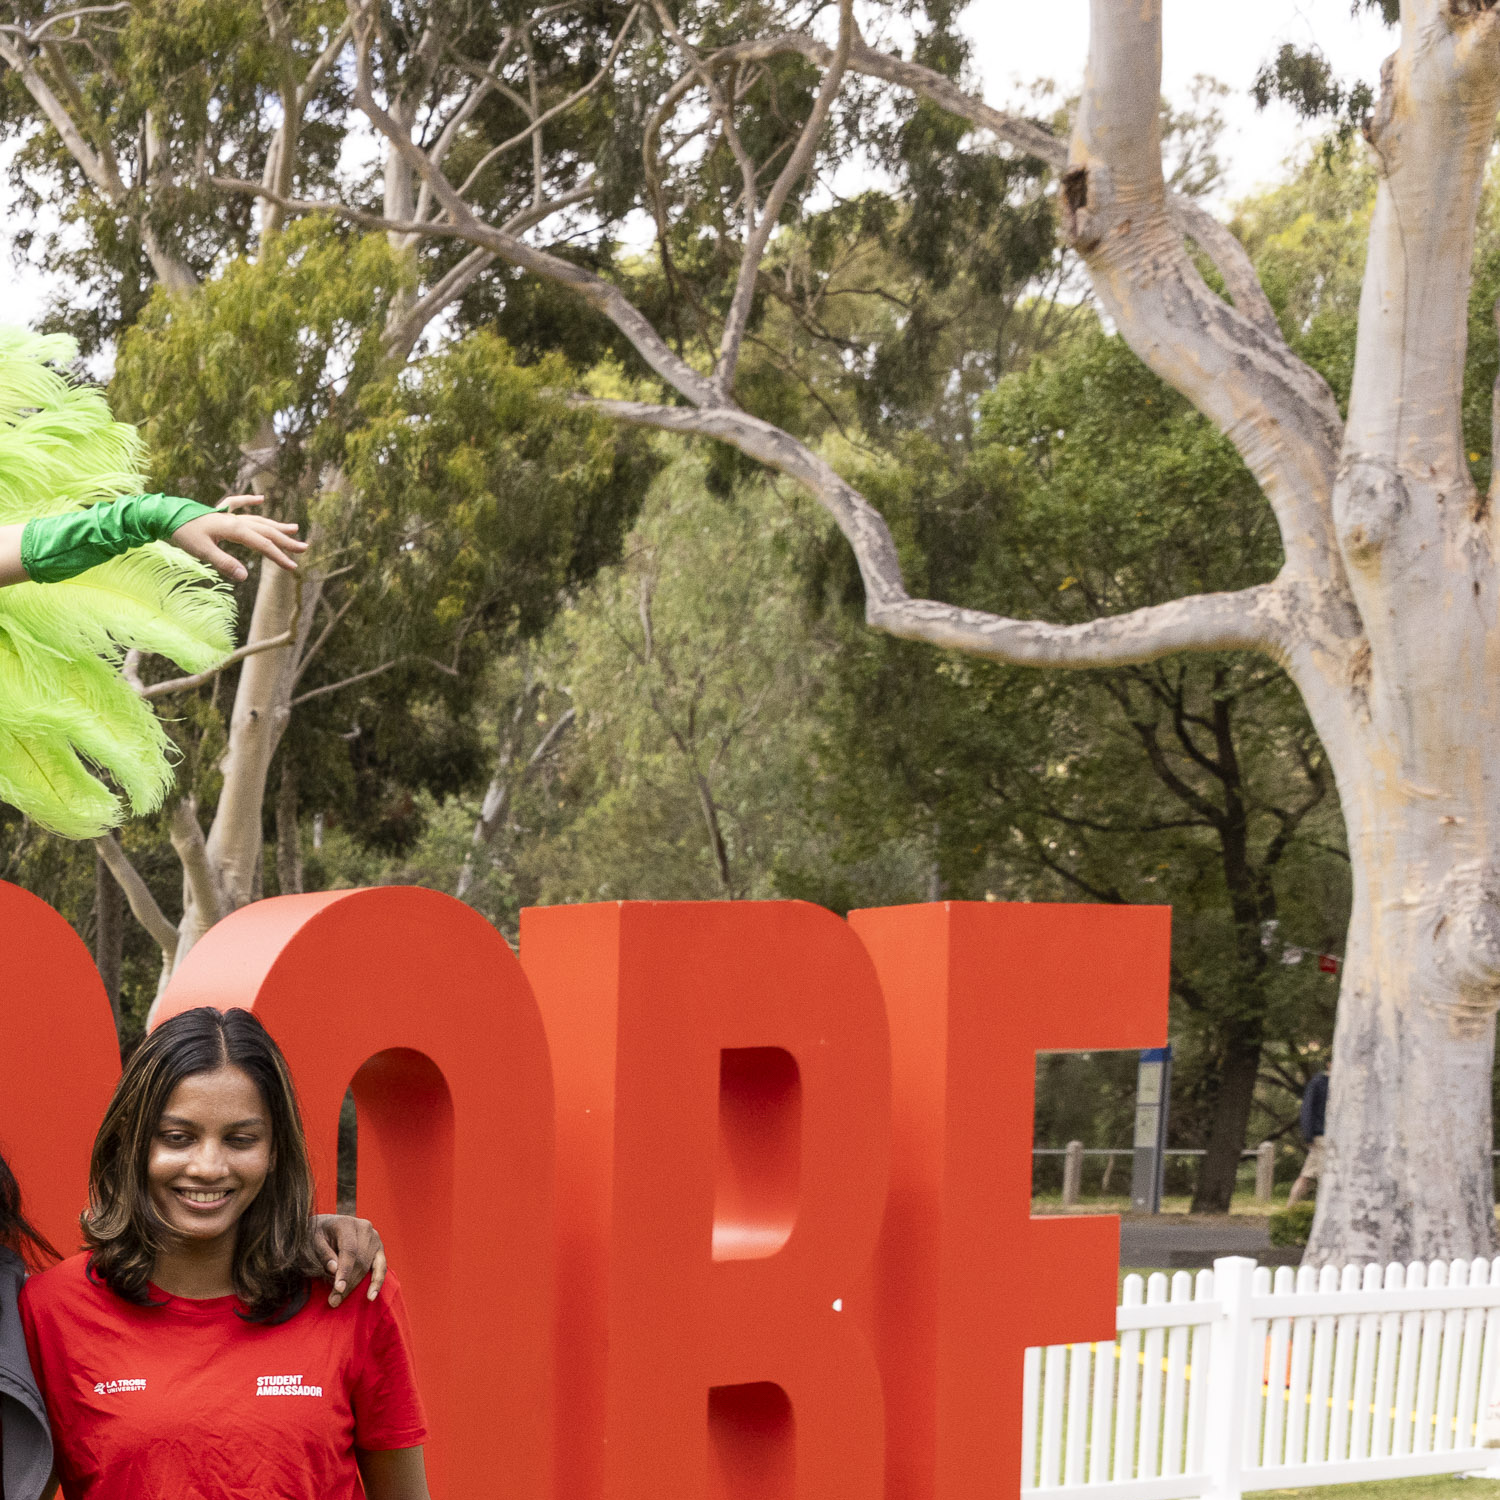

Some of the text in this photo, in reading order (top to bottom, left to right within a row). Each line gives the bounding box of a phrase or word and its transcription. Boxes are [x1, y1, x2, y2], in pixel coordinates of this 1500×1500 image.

[106, 1378, 147, 1388] LA TROBE
[256, 1374, 304, 1387] STUDENT
[106, 1385, 146, 1394] UNIVERSITY
[255, 1385, 323, 1398] AMBASSADOR
